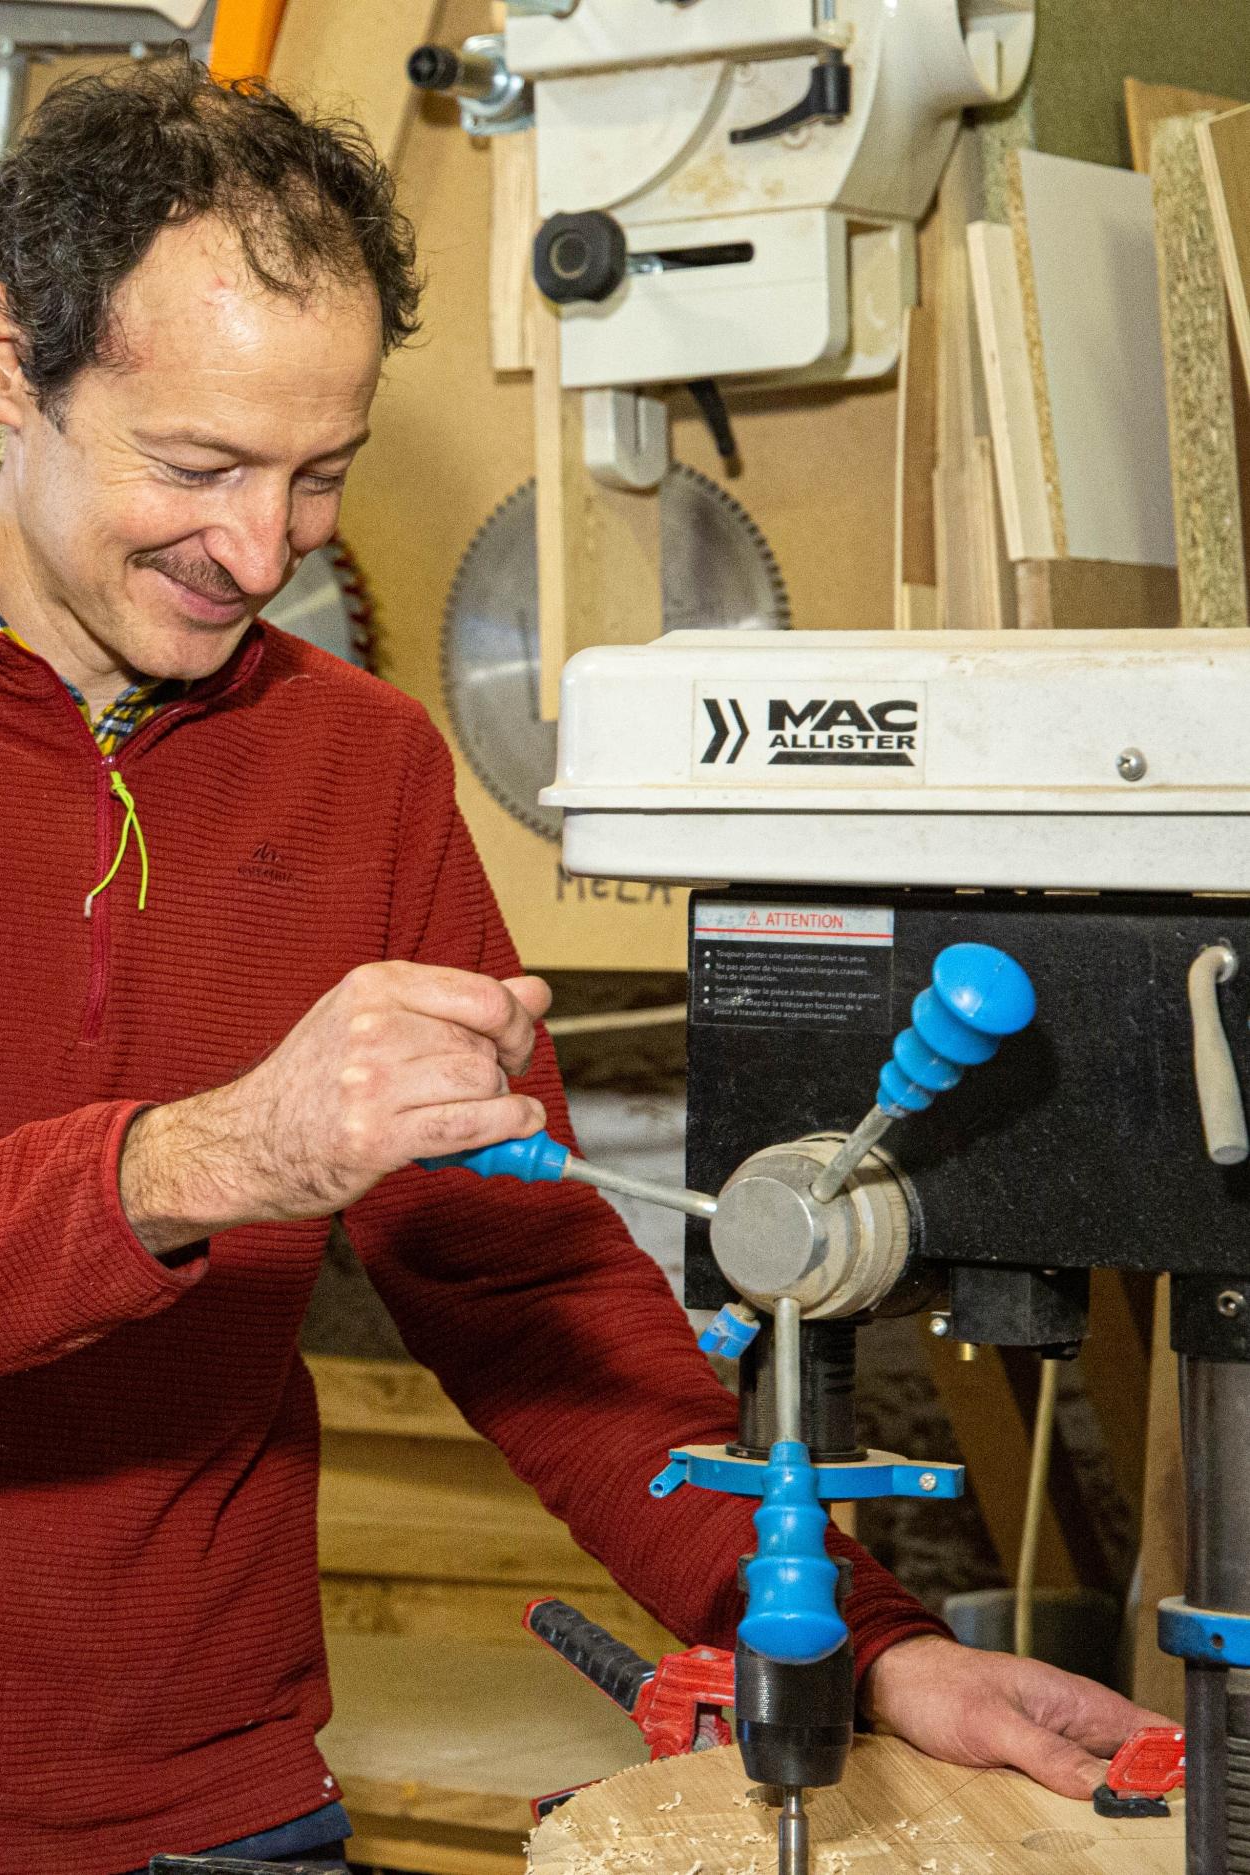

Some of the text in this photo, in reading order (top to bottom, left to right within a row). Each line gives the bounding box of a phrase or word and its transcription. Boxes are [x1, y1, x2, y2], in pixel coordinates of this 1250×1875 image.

[768, 699, 918, 733] MAC
[769, 734, 916, 750] ALLISTER
[765, 911, 844, 928] ATTENTION
